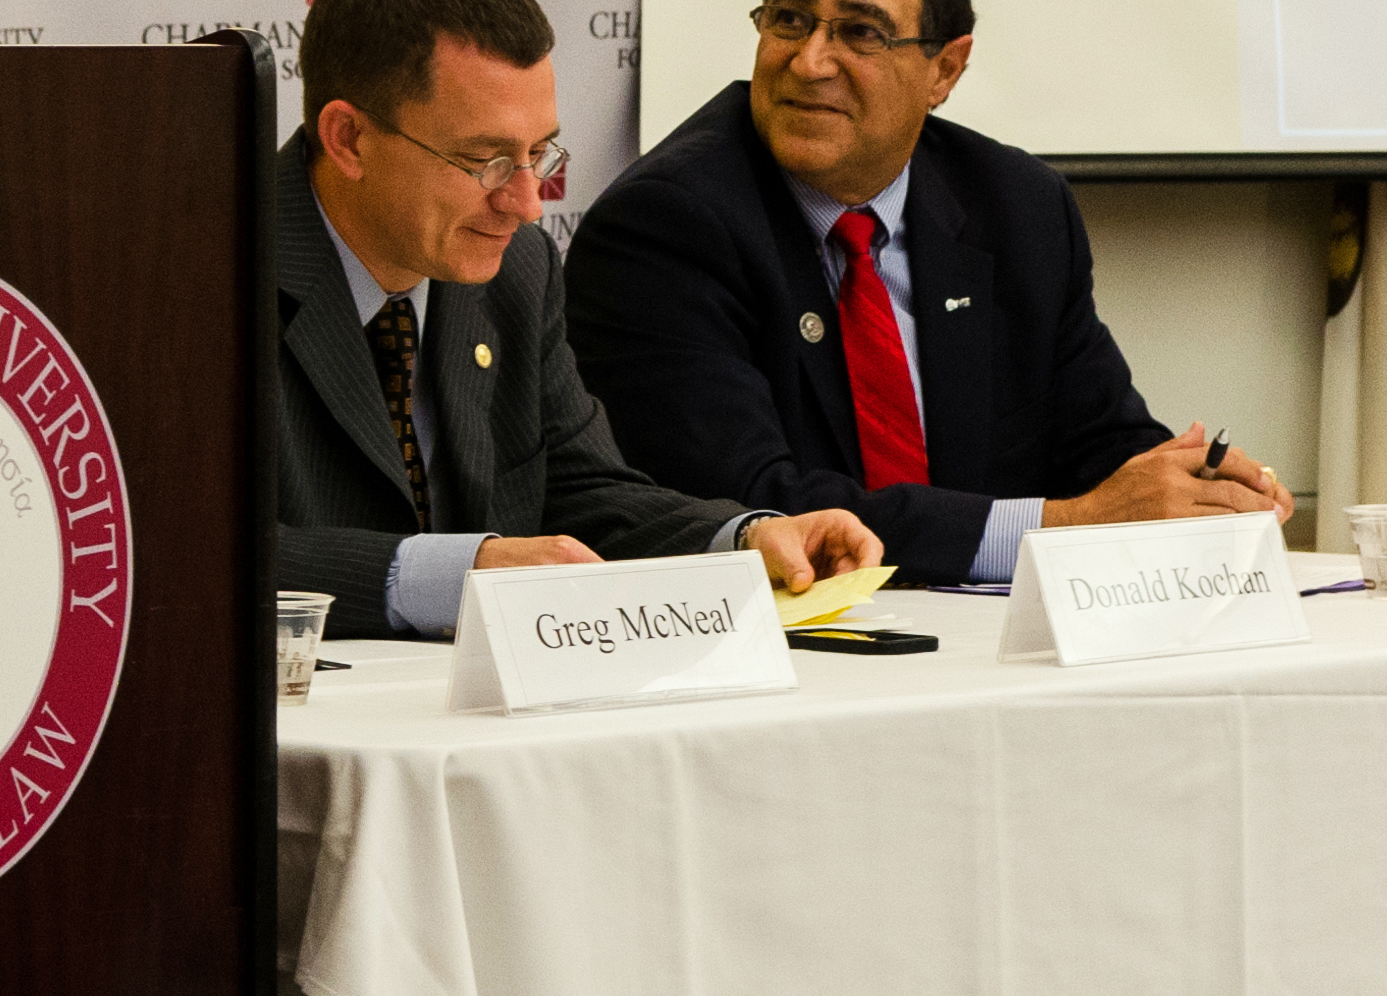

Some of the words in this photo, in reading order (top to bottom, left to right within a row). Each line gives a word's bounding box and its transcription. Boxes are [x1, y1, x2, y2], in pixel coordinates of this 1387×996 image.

[1067, 569, 1173, 611] Donald
[1171, 563, 1272, 601] Kochan
[536, 613, 616, 654] Greg
[615, 598, 738, 642] McNeal
